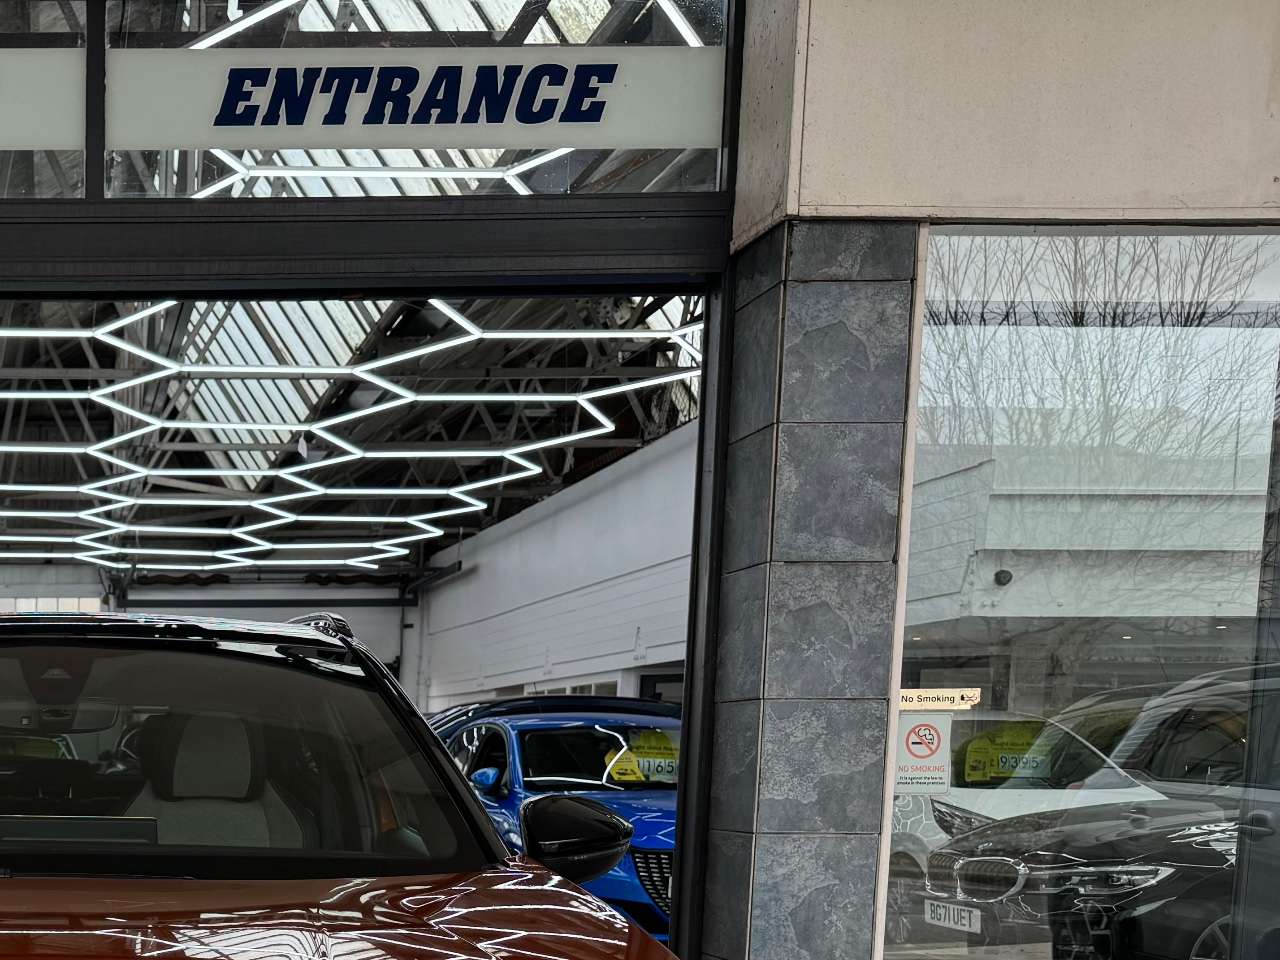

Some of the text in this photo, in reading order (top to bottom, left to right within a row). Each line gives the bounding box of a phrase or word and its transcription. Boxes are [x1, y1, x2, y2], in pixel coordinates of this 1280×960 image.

[213, 63, 619, 127] ENTRANCE
[901, 694, 956, 704] No Smoking
[898, 765, 945, 774] NO SMOKING
